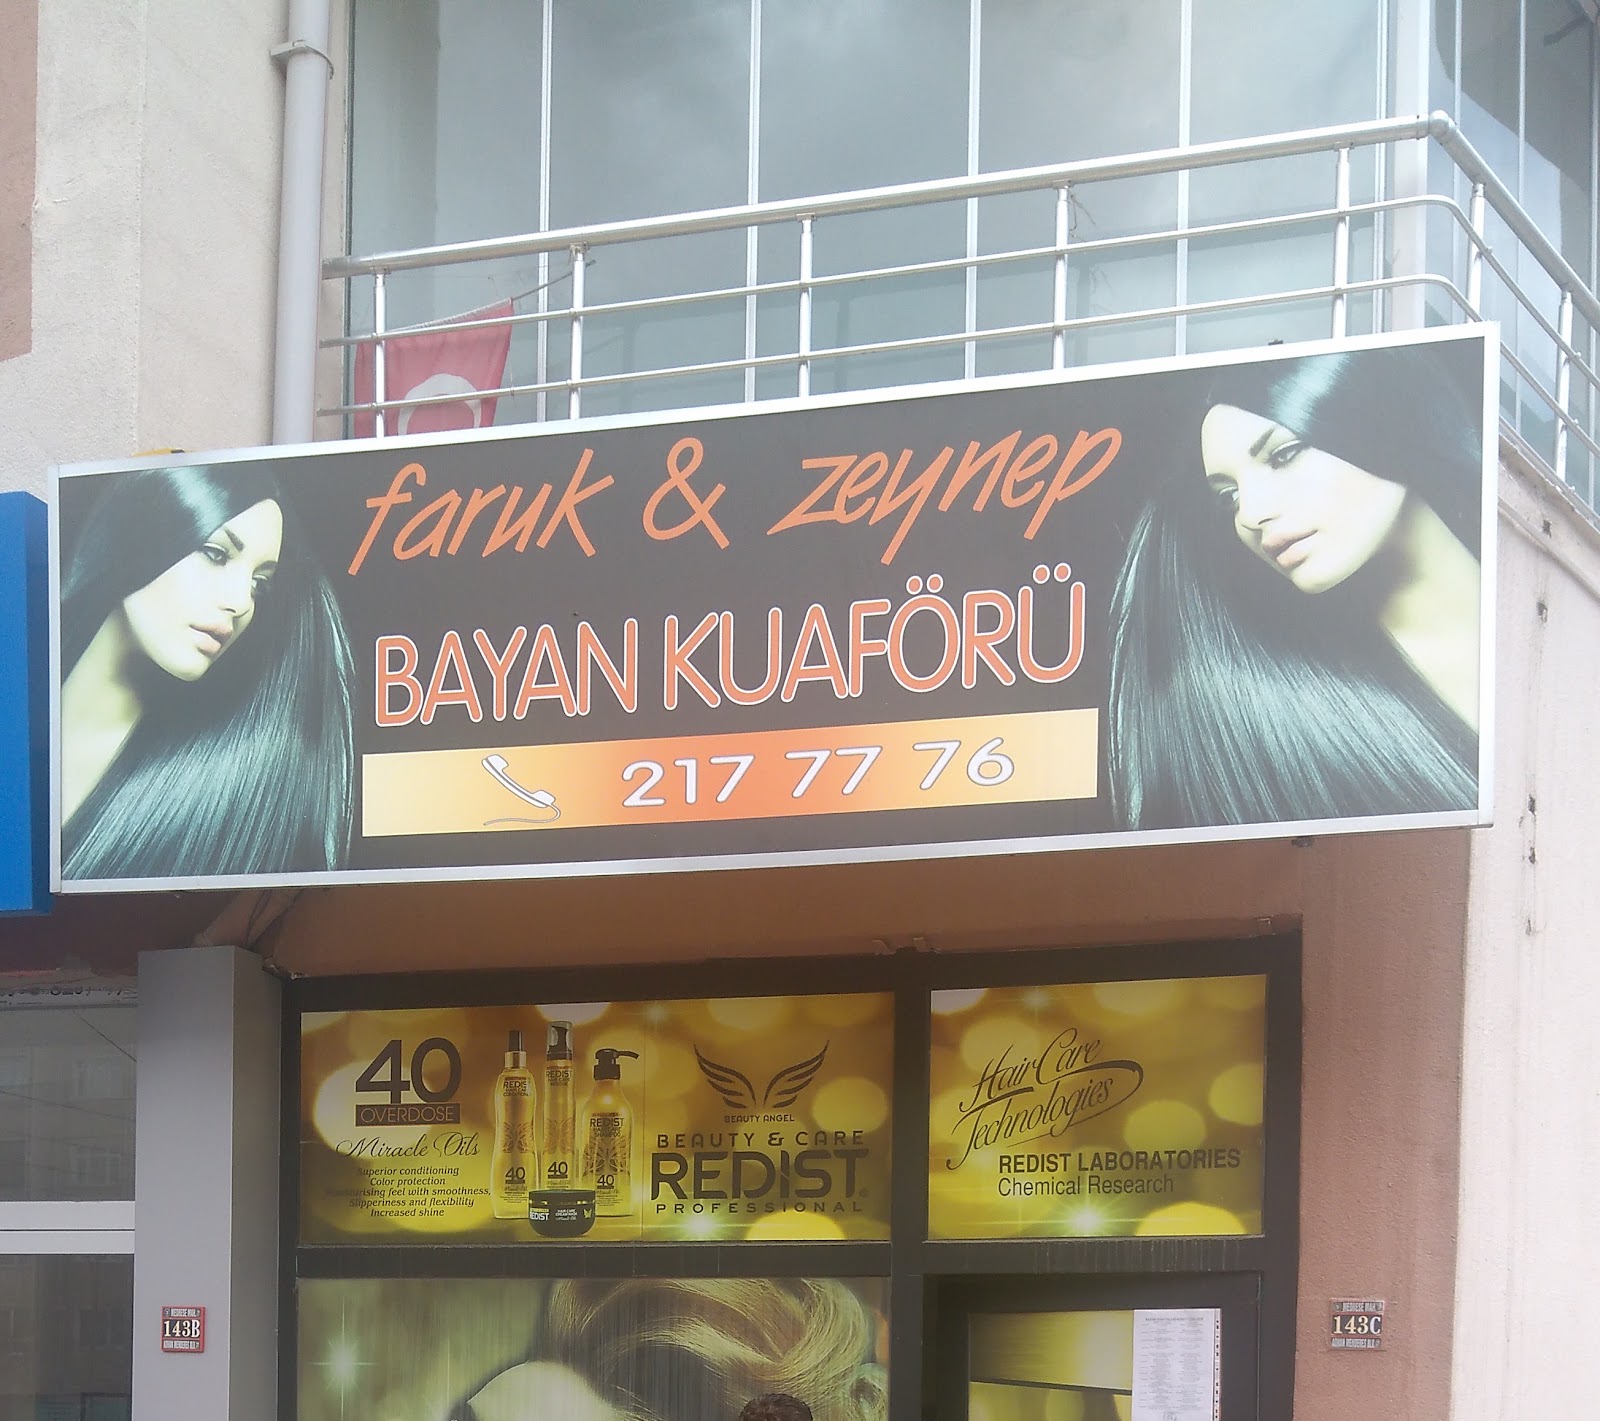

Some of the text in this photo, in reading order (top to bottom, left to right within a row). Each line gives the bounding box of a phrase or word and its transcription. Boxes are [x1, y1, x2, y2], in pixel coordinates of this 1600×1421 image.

[348, 427, 1122, 576] faruk & zeynep
[374, 563, 1087, 727] BAYAN KUAFÖRÜ
[620, 736, 1015, 808] 217 77 76
[355, 1037, 462, 1104] 40
[959, 1027, 1101, 1113] Hair Care
[503, 1080, 530, 1090] REDIS
[360, 1106, 454, 1123] OVERDOSE
[590, 1117, 624, 1128] REDIST
[724, 1114, 795, 1123] BEAUTY ANGEL
[946, 1076, 1115, 1170] Technologies
[336, 1131, 480, 1158] Miracle Oils
[657, 1130, 864, 1149] BEAUTY & CARE
[547, 1161, 568, 1175] 40
[999, 1149, 1241, 1173] REDIST LABORATORIES
[357, 1166, 459, 1177] Superior conditioning
[505, 1166, 526, 1180] 40
[597, 1174, 615, 1186] 40
[651, 1149, 869, 1200] REDIST
[370, 1177, 446, 1187] Color protection
[998, 1174, 1174, 1196] Chemical Research
[388, 1187, 406, 1197] feel
[408, 1187, 430, 1195] with
[431, 1186, 491, 1196] smoothness,
[408, 1198, 427, 1206] and
[428, 1197, 475, 1208] flexibility
[656, 1202, 863, 1214] PROFESSIONAL
[370, 1208, 445, 1217] Increased shine
[164, 1319, 200, 1337] 143B
[1333, 1315, 1381, 1334] 143C
